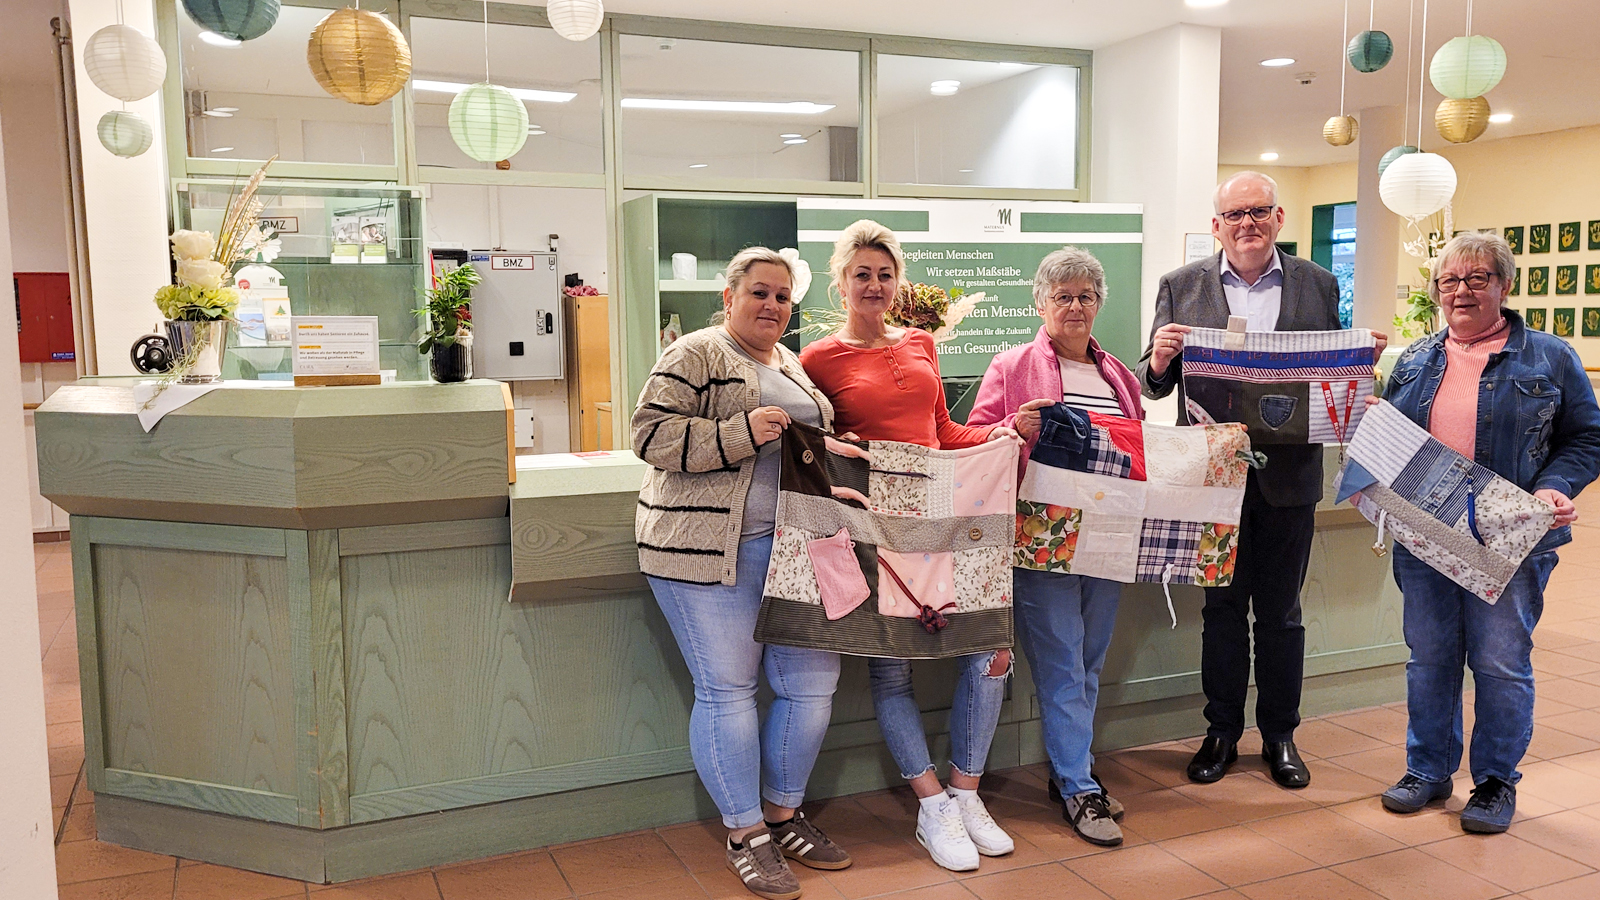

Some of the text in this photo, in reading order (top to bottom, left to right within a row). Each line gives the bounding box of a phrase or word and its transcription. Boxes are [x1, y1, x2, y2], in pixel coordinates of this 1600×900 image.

[901, 249, 994, 262] begleiten Menschen
[503, 258, 523, 267] BMZ
[926, 266, 1021, 277] Wir setzen Maßstäbe
[953, 278, 1034, 288] Wir gestalten Gesundheit
[981, 294, 999, 302] kunft
[990, 304, 1040, 317] Mensche
[956, 328, 983, 336] handeln
[984, 327, 994, 335] für
[995, 327, 1005, 335] die
[1006, 327, 1032, 335] Zukunft
[936, 340, 1024, 355] alten Gesundhe
[1184, 347, 1213, 359] Bes
[1324, 389, 1334, 408] REWE
[1347, 388, 1356, 407] REWE
